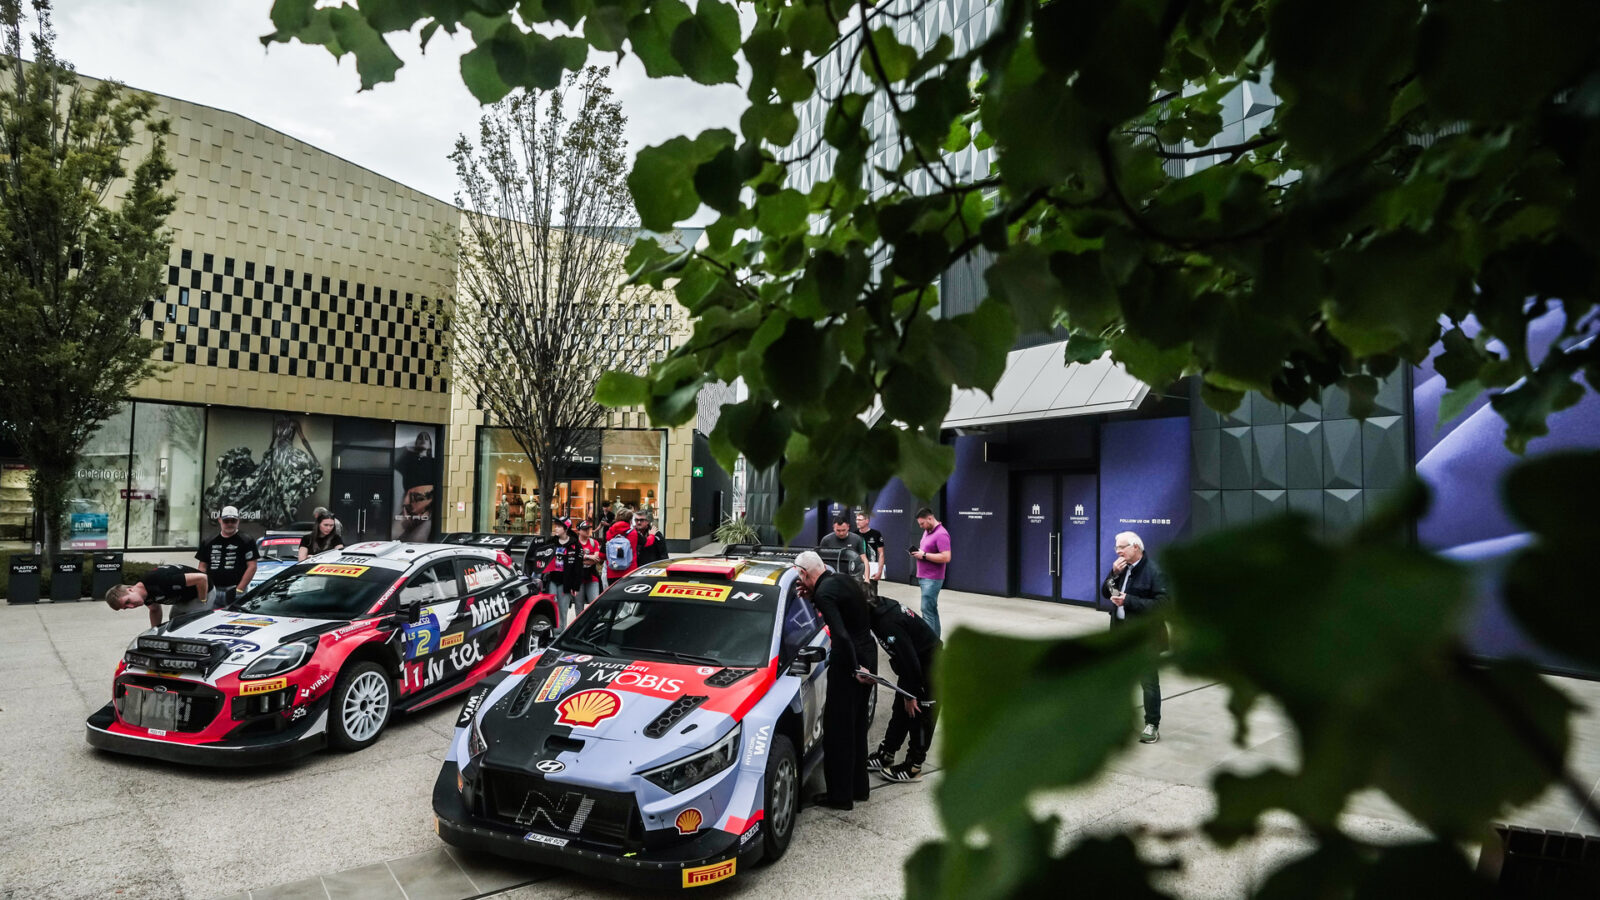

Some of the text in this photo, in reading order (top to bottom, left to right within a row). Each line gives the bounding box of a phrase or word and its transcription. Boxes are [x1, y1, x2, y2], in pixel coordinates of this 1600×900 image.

[336, 556, 371, 564] Mitti
[313, 565, 363, 576] PIRELLI
[377, 586, 397, 606] STORENT
[657, 584, 724, 599] PIRELLI
[470, 591, 511, 628] Mitti
[408, 632, 416, 641] LS
[416, 629, 432, 657] 2
[441, 634, 463, 647] PIRELLI
[450, 638, 484, 670] tet
[587, 661, 650, 673] HYUNDAI
[243, 681, 283, 693] PIRELLI
[310, 673, 330, 691] VIRŠI
[587, 669, 686, 695] MOBIS
[688, 862, 733, 884] PIRELLI
